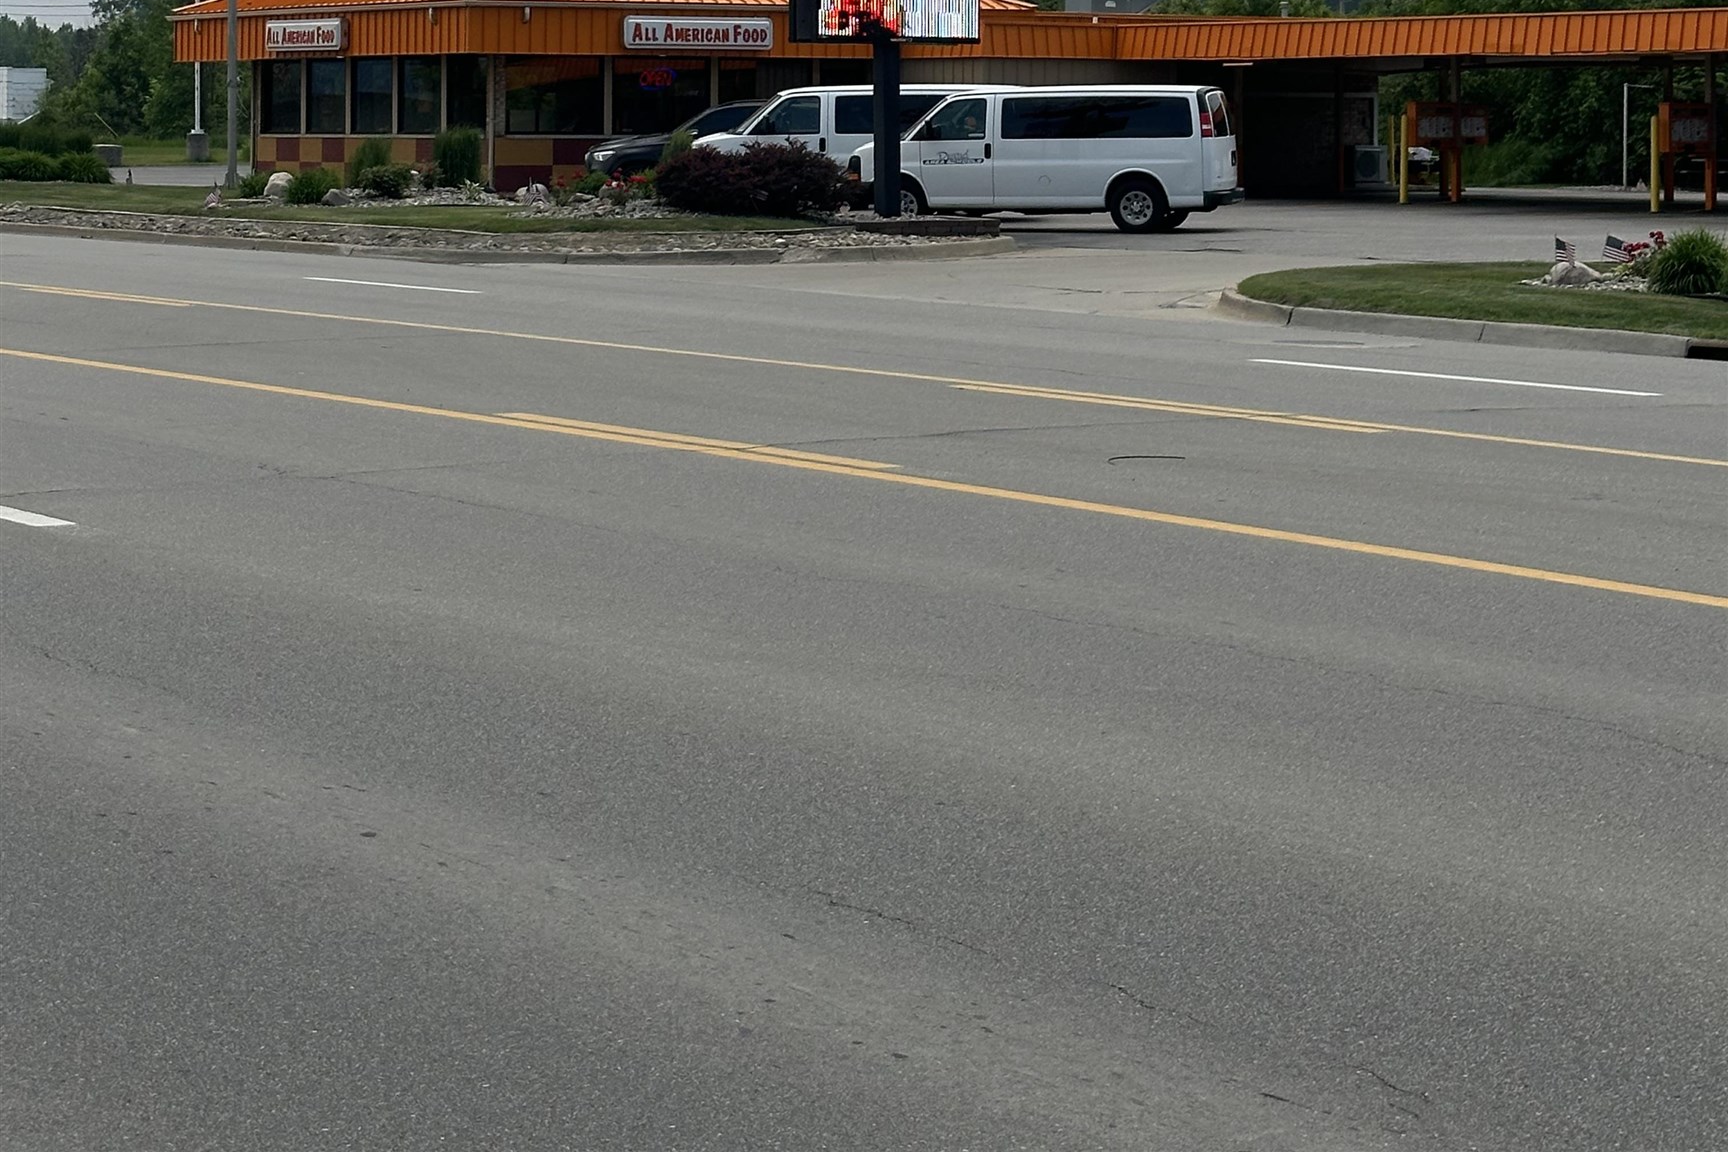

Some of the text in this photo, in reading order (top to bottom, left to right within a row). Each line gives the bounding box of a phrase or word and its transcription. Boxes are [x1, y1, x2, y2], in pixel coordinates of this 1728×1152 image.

[266, 26, 335, 45] ALL AMERICAN FOOD
[632, 22, 768, 44] ALL AMERICAN FOOD
[640, 68, 674, 87] OPEN
